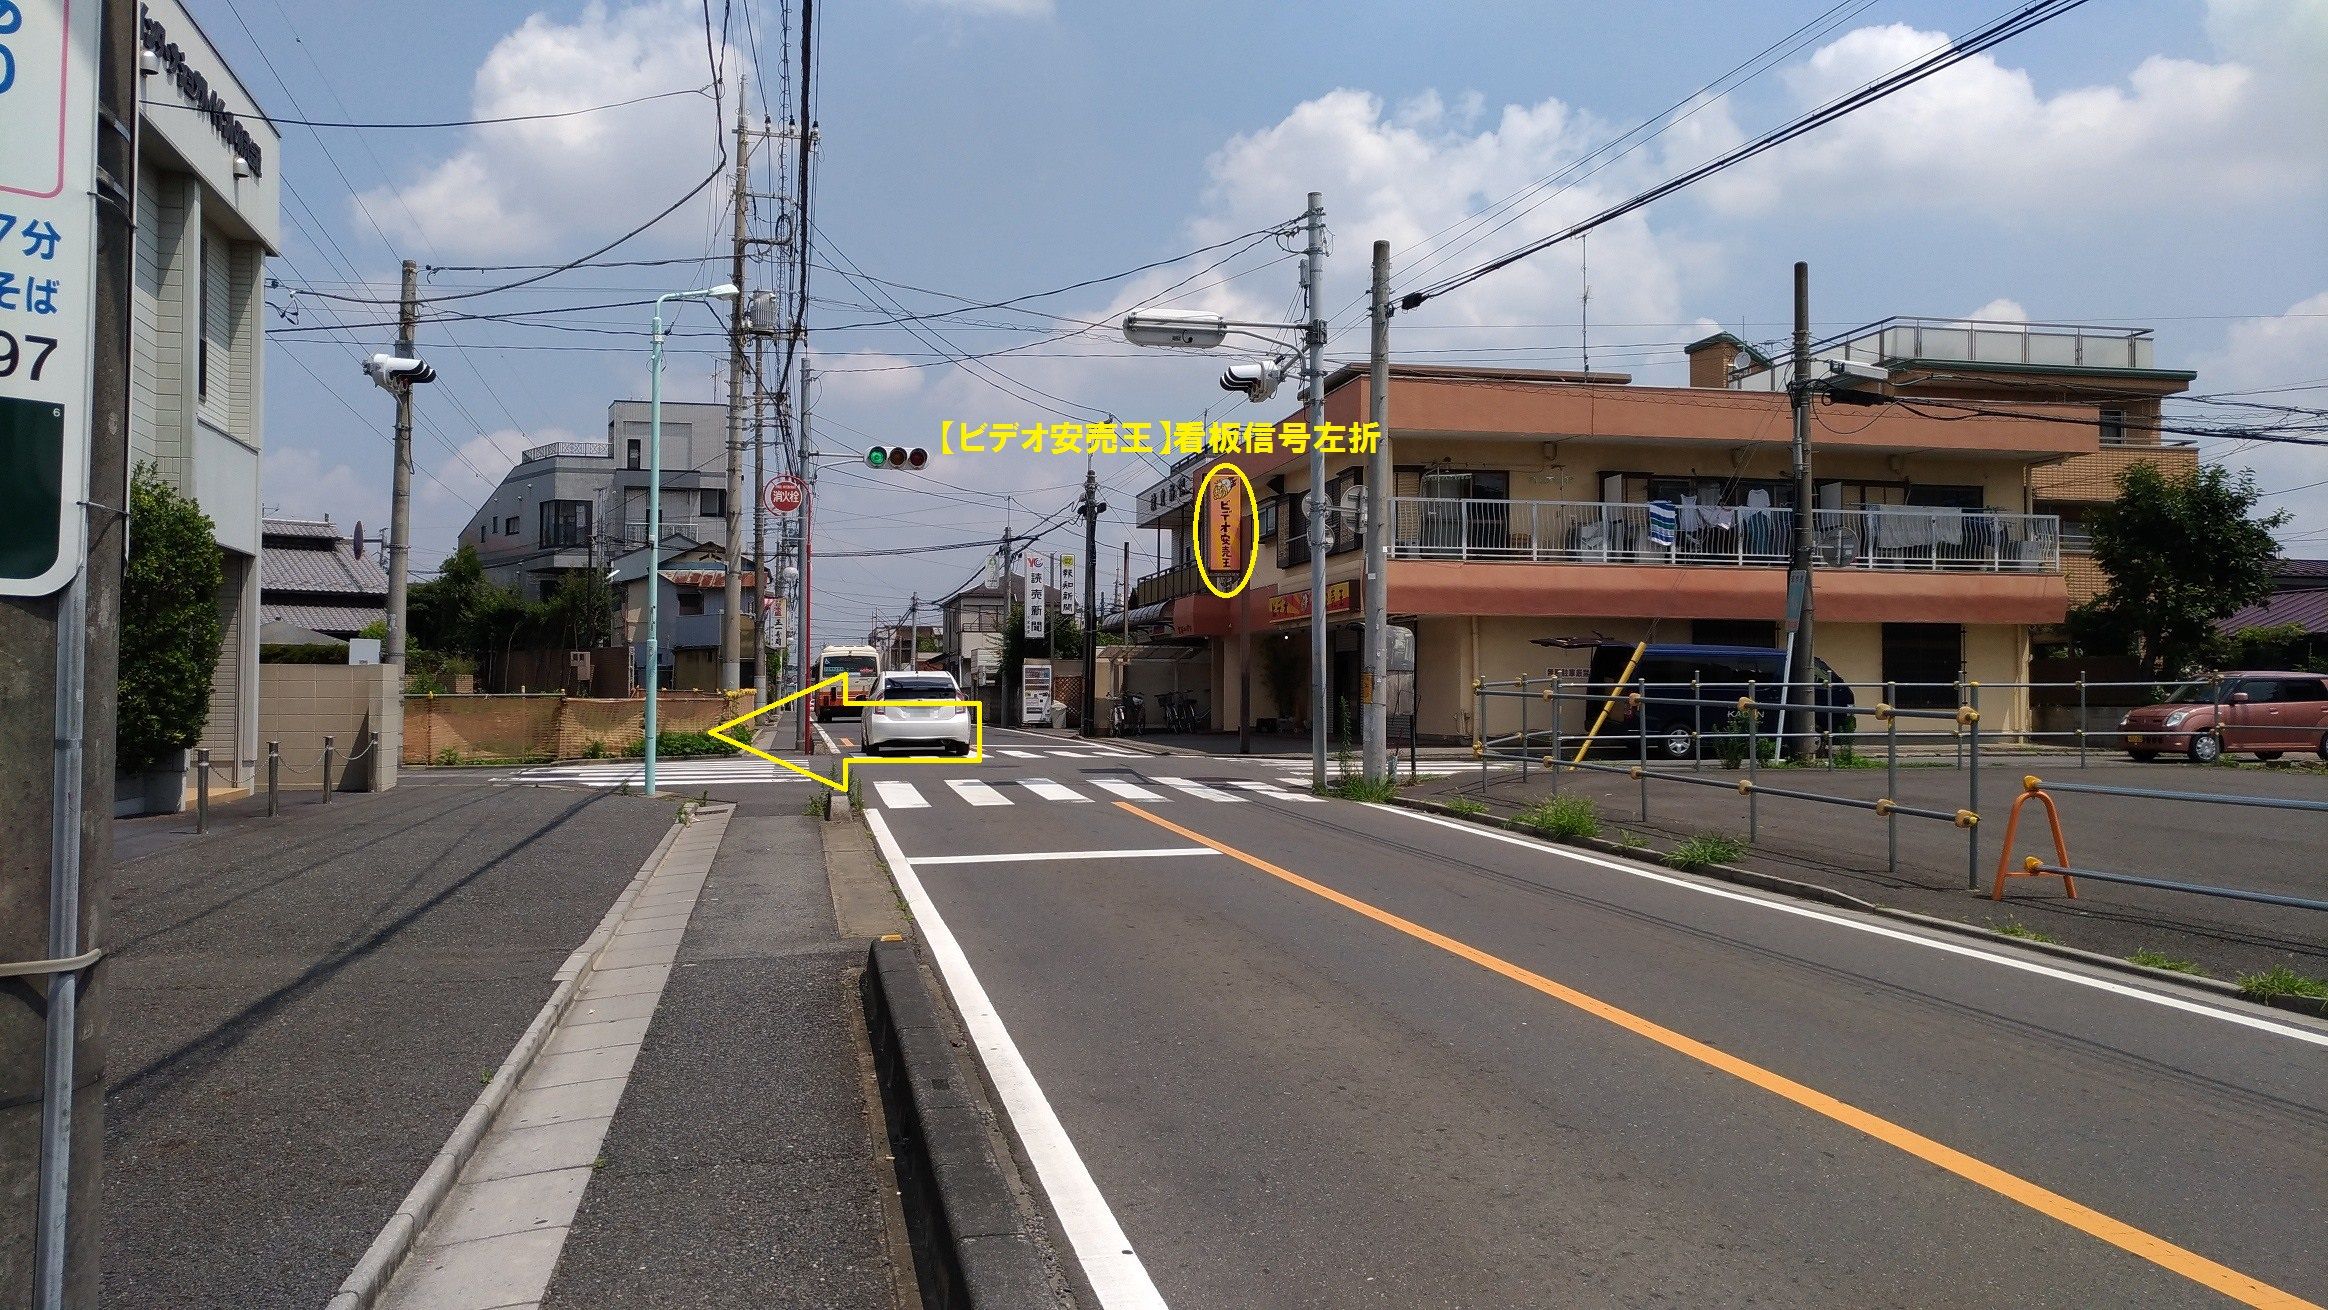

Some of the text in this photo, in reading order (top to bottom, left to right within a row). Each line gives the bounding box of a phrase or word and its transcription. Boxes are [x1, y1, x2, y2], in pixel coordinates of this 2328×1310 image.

[773, 490, 800, 503] 消火栓
[1220, 499, 1232, 568] ビデオ安売王
[1030, 572, 1043, 632] 読売新聞
[1062, 568, 1074, 612] 報知新聞
